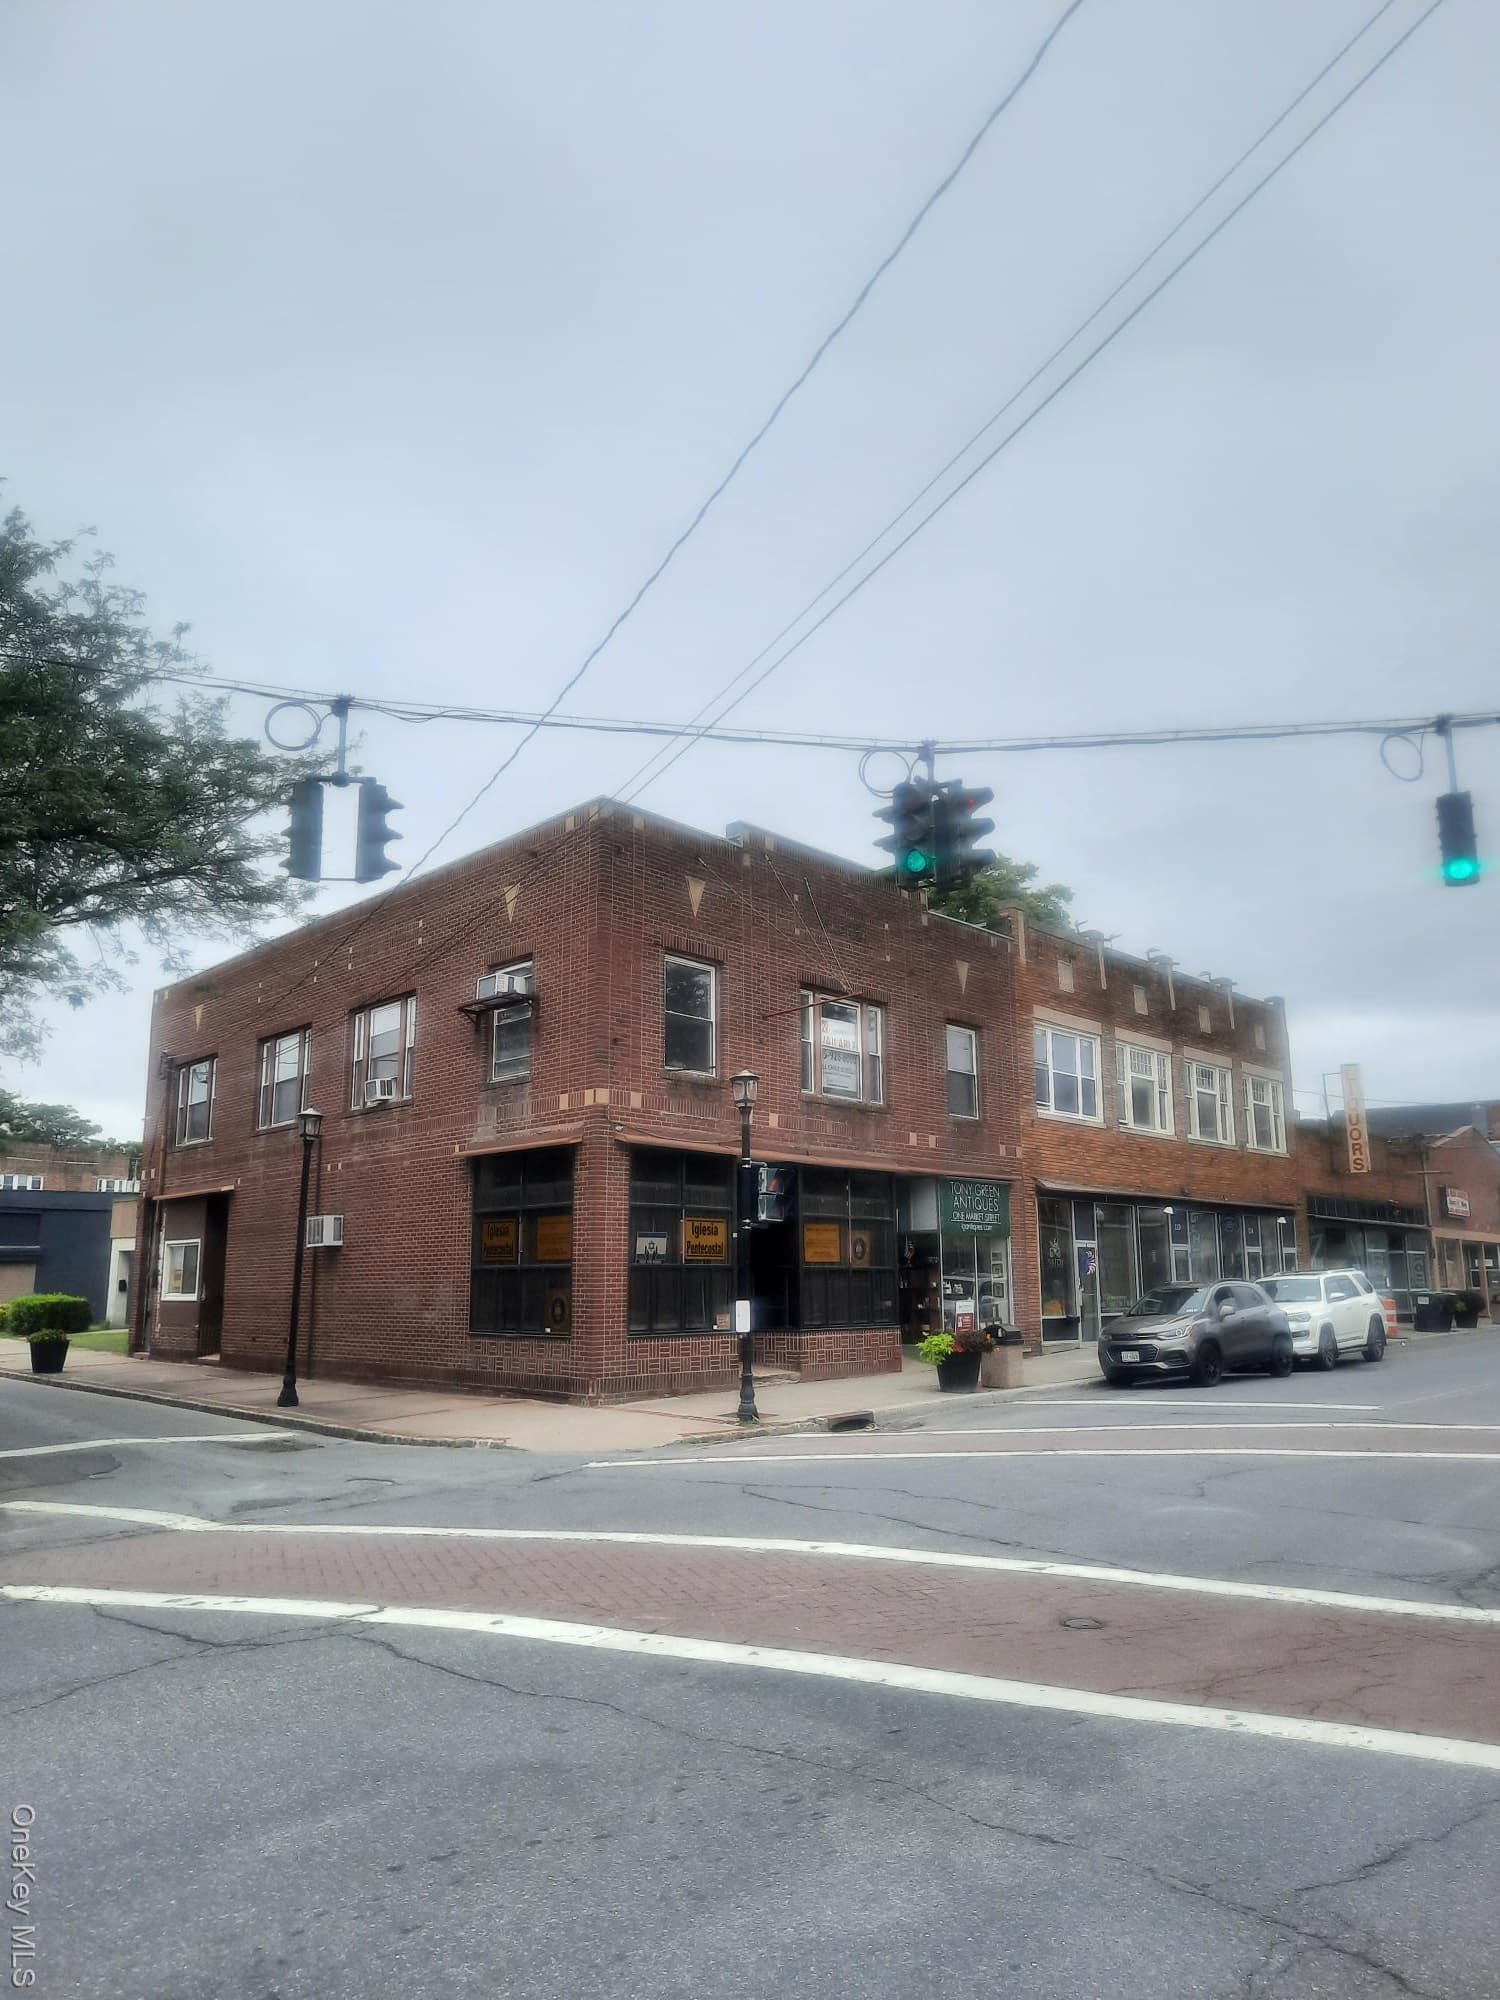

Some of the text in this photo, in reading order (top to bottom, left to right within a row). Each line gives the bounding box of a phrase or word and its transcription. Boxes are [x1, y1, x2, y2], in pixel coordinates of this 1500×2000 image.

[949, 1181, 1000, 1198] TONY GREEN
[953, 1196, 999, 1212] ANTIQUES
[952, 1211, 965, 1220] ONE
[966, 1212, 984, 1221] MARKET
[691, 1223, 719, 1239] Iglesia
[686, 1241, 724, 1255] Pentecostal
